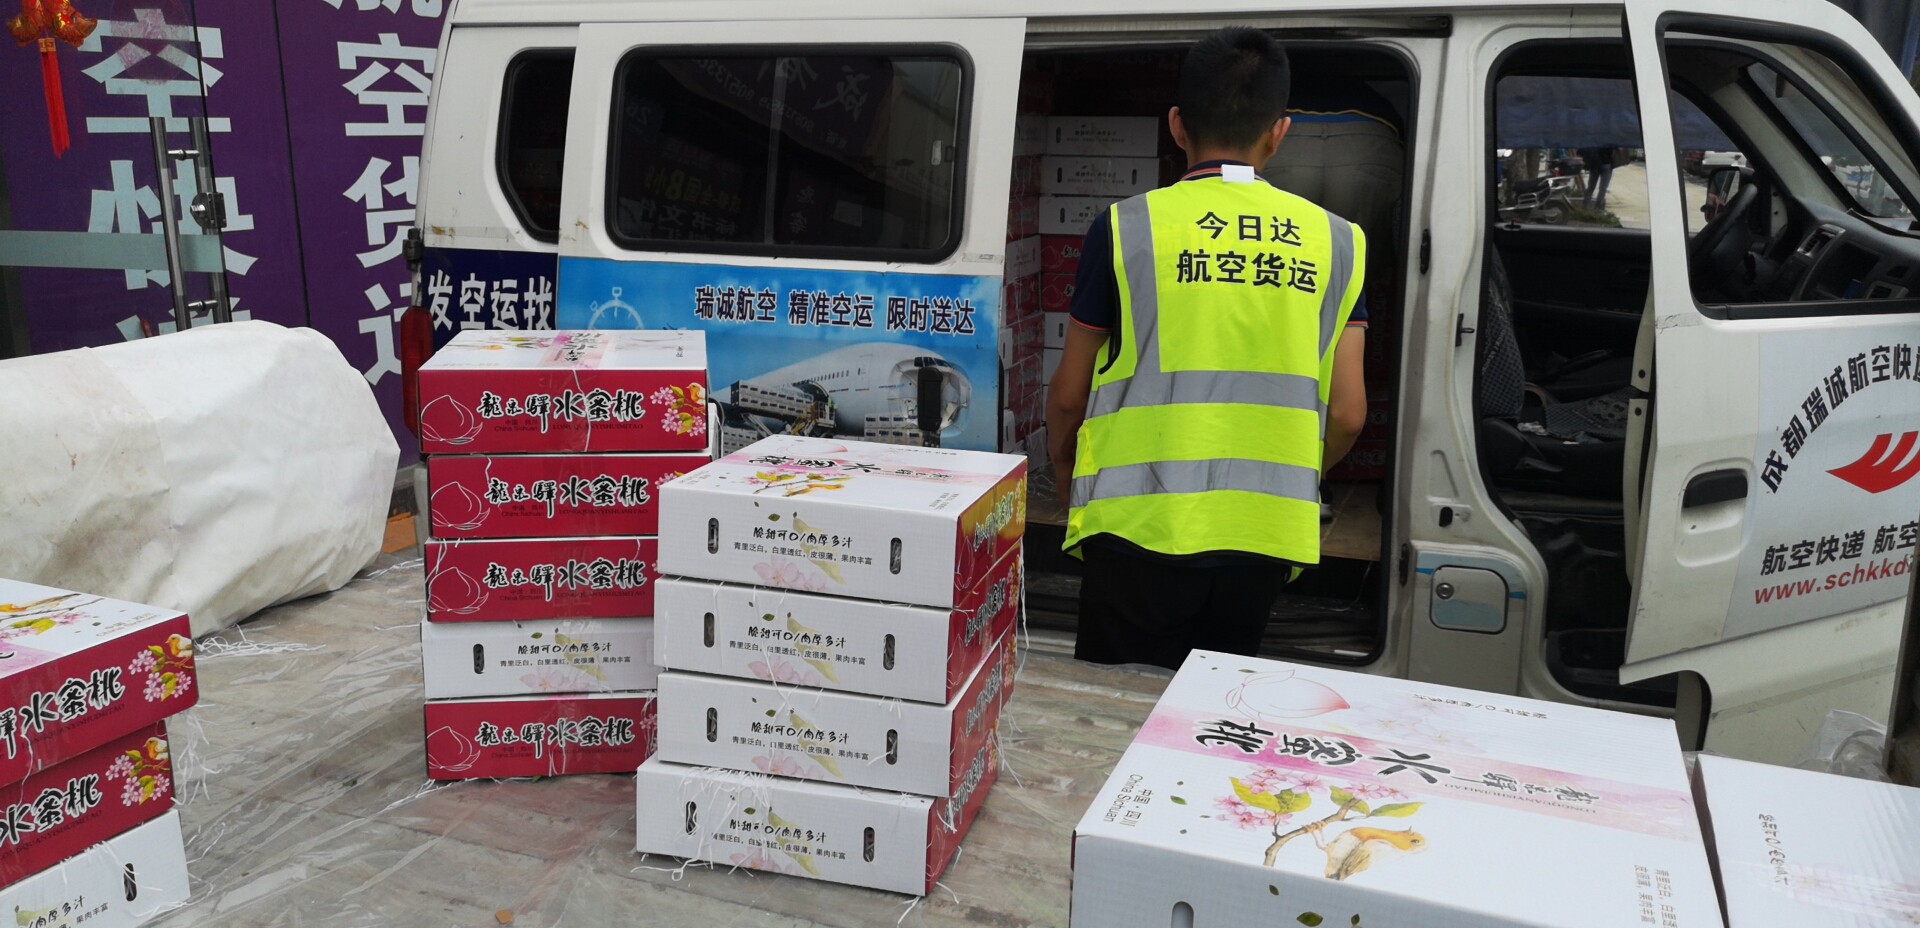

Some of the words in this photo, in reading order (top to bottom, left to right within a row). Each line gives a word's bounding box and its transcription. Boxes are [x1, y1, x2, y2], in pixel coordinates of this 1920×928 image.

[77, 8, 259, 342] 空快
[1195, 211, 1302, 247] 今日达
[1176, 249, 1319, 295] 航空货运
[427, 269, 553, 331] 发空运找
[694, 285, 777, 322] 瑞诚航空
[788, 289, 874, 328] 精准空运
[885, 296, 976, 335] 限时送达
[1760, 529, 1866, 577] 航空快递
[1872, 521, 1917, 556] 航空
[1754, 554, 1913, 604] www.schkkd
[1103, 794, 1131, 822] Sichuan
[1121, 774, 1143, 793] China
